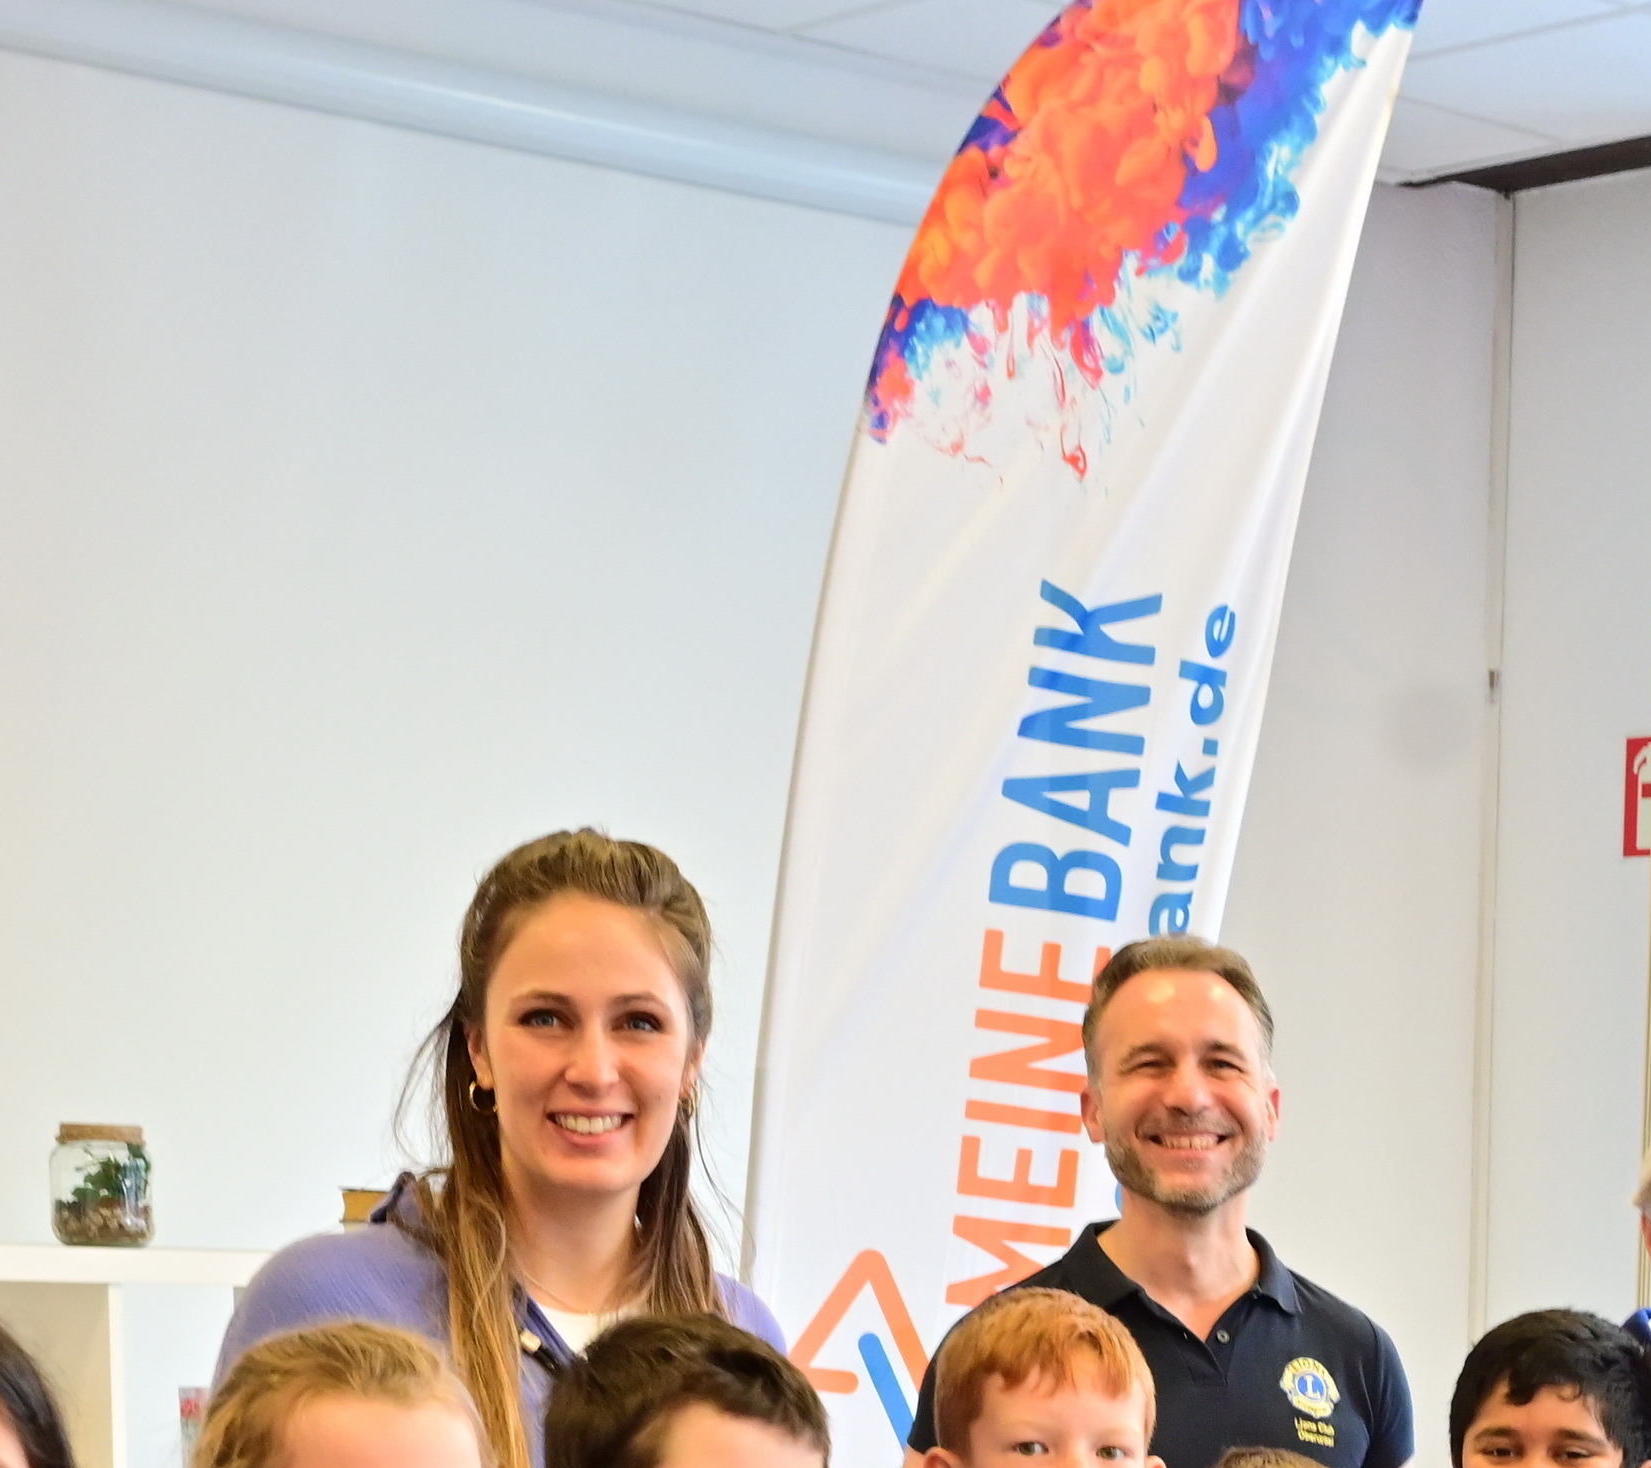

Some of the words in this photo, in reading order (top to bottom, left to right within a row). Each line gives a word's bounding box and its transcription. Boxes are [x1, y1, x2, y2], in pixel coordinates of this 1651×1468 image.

[987, 579, 1163, 922] BANK
[1148, 604, 1236, 937] ank.de
[945, 929, 1110, 1307] MEINE
